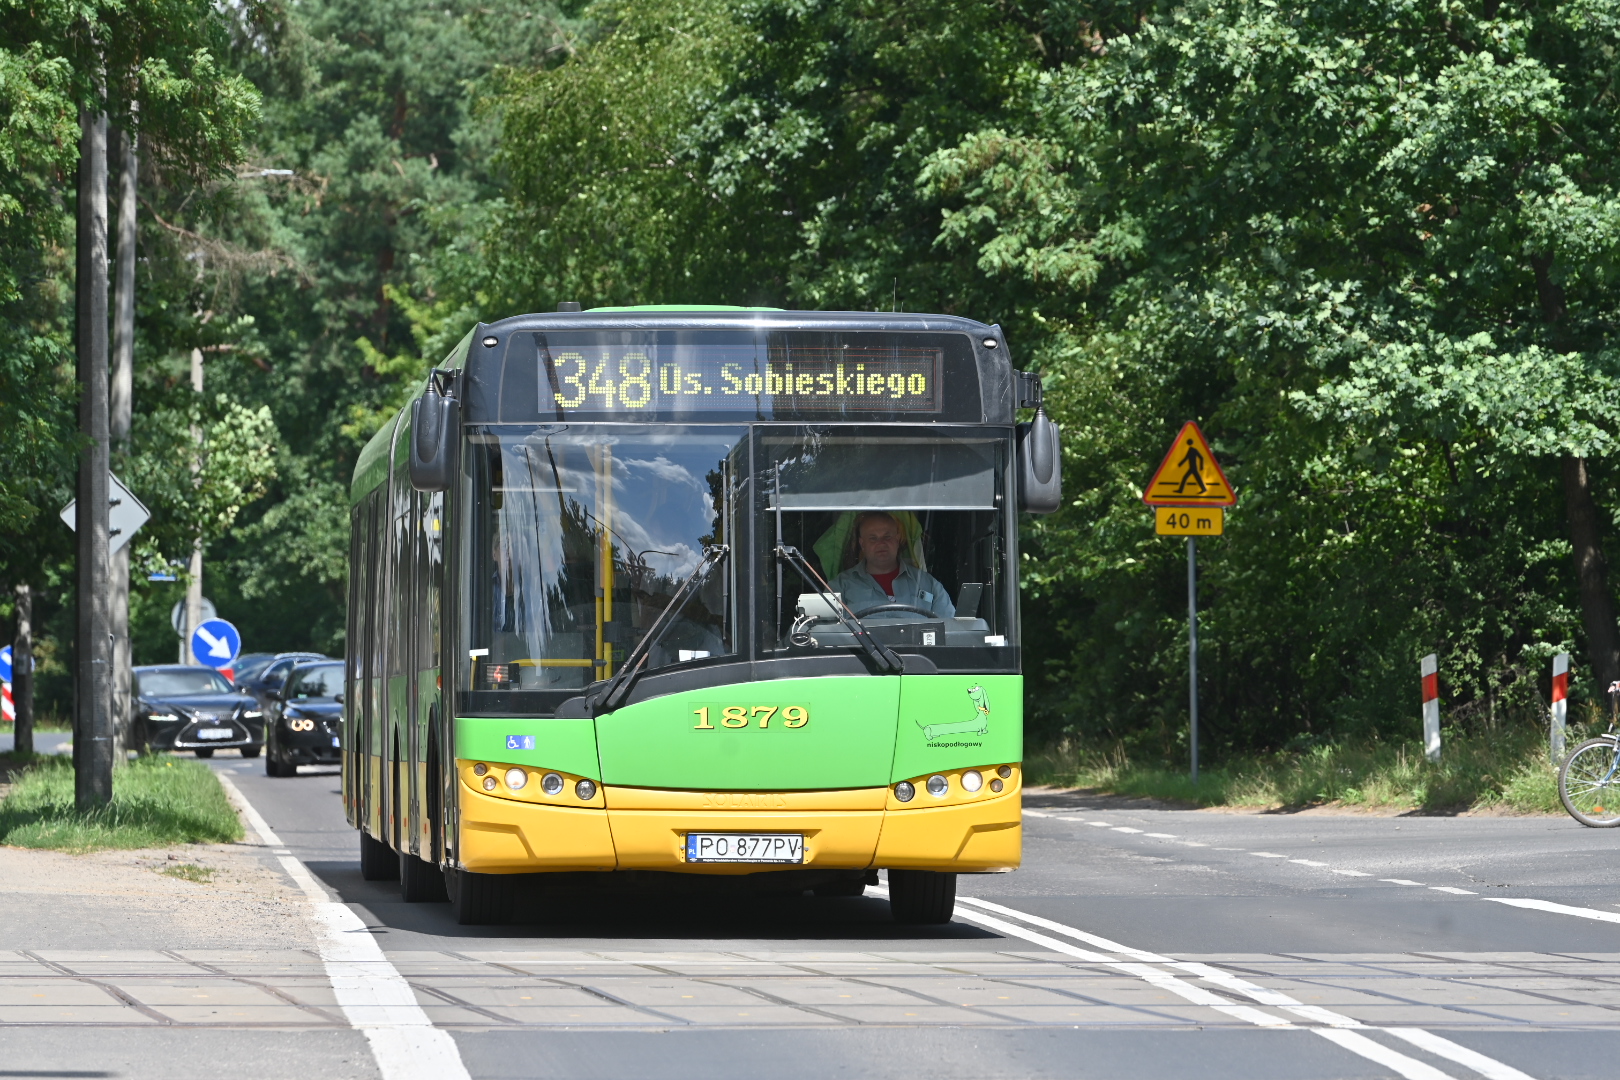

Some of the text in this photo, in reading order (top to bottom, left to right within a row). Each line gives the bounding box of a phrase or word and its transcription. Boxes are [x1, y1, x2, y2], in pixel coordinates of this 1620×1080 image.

[554, 352, 926, 408] 348 Os. Sobieskiego
[1166, 513, 1212, 529] 40 m
[693, 706, 810, 729] 1879
[927, 741, 983, 749] niskopodłogowy
[702, 792, 787, 808] SOLARIS
[700, 837, 799, 857] PO 877PV
